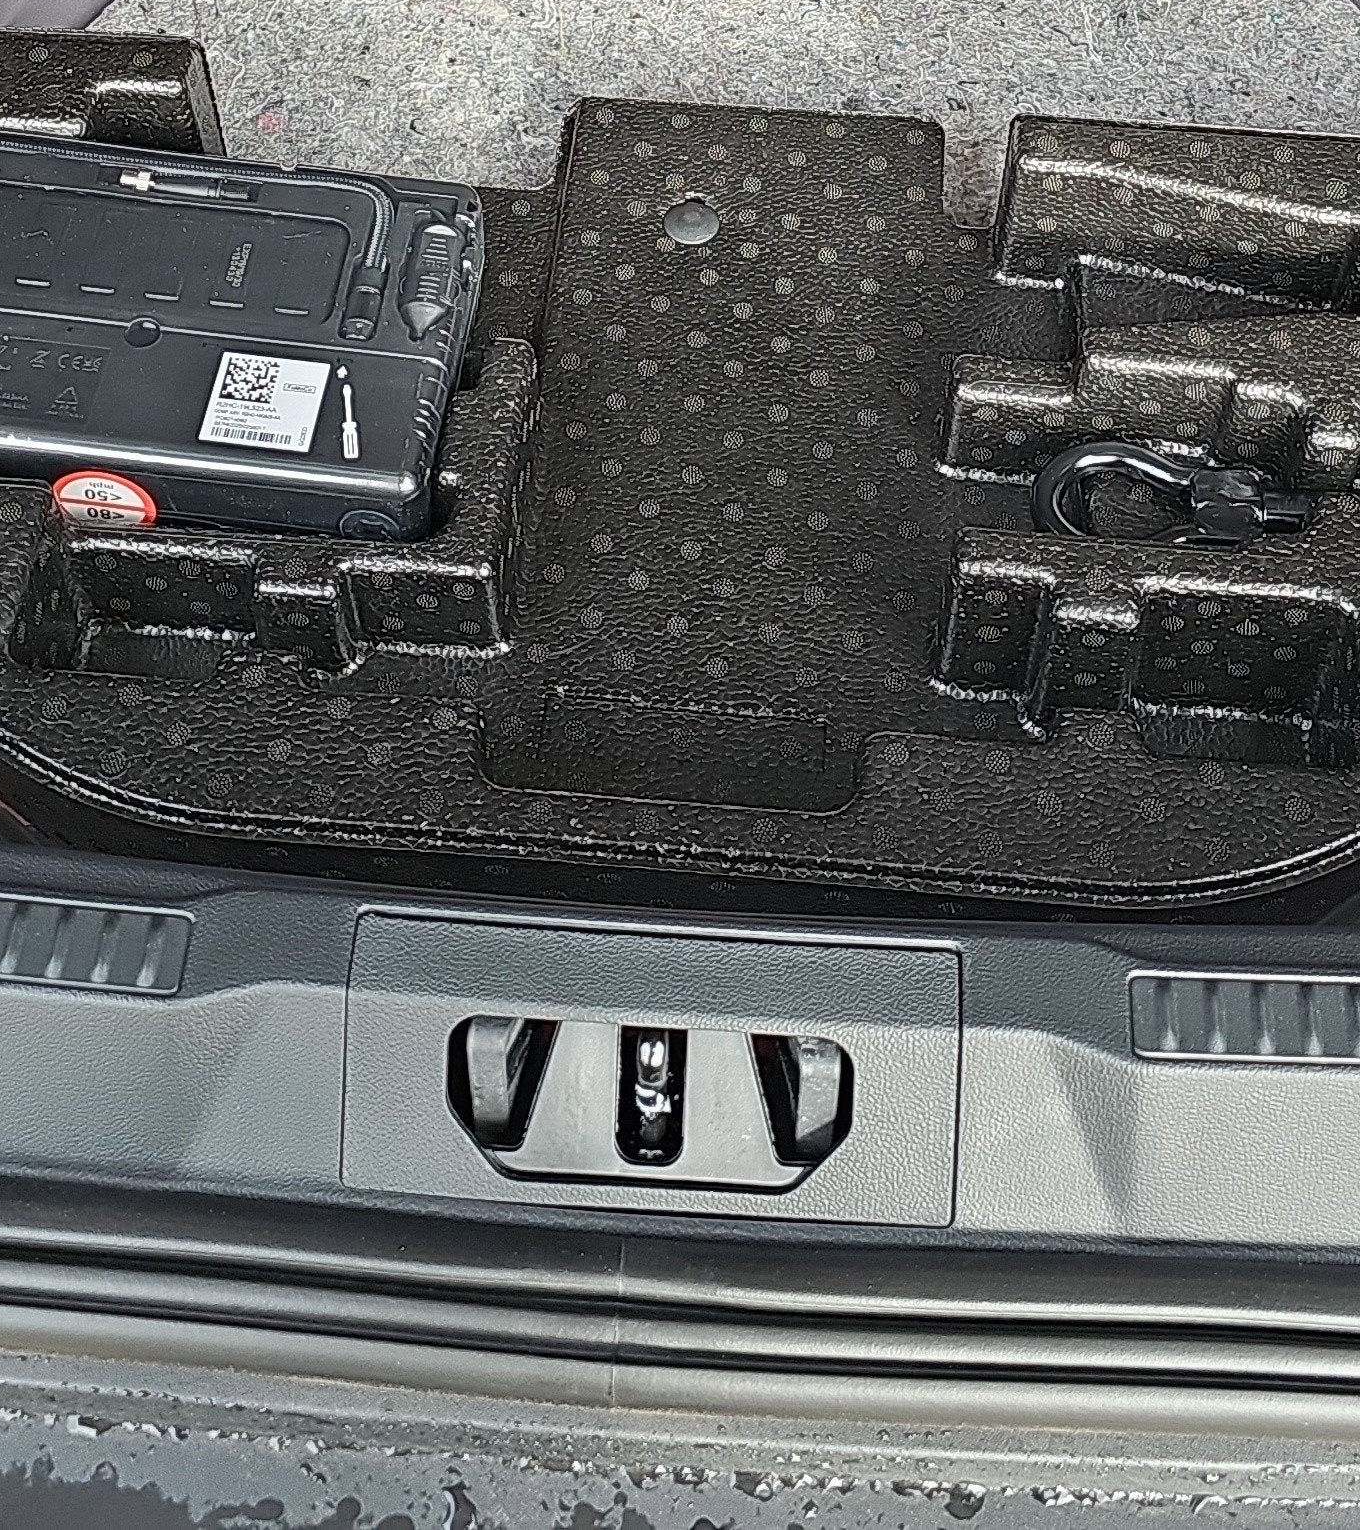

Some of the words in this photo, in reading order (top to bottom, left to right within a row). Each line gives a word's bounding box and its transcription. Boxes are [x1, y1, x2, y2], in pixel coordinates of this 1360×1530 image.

[89, 481, 114, 490] mph
[84, 489, 122, 501] <50
[87, 507, 125, 520] <80
